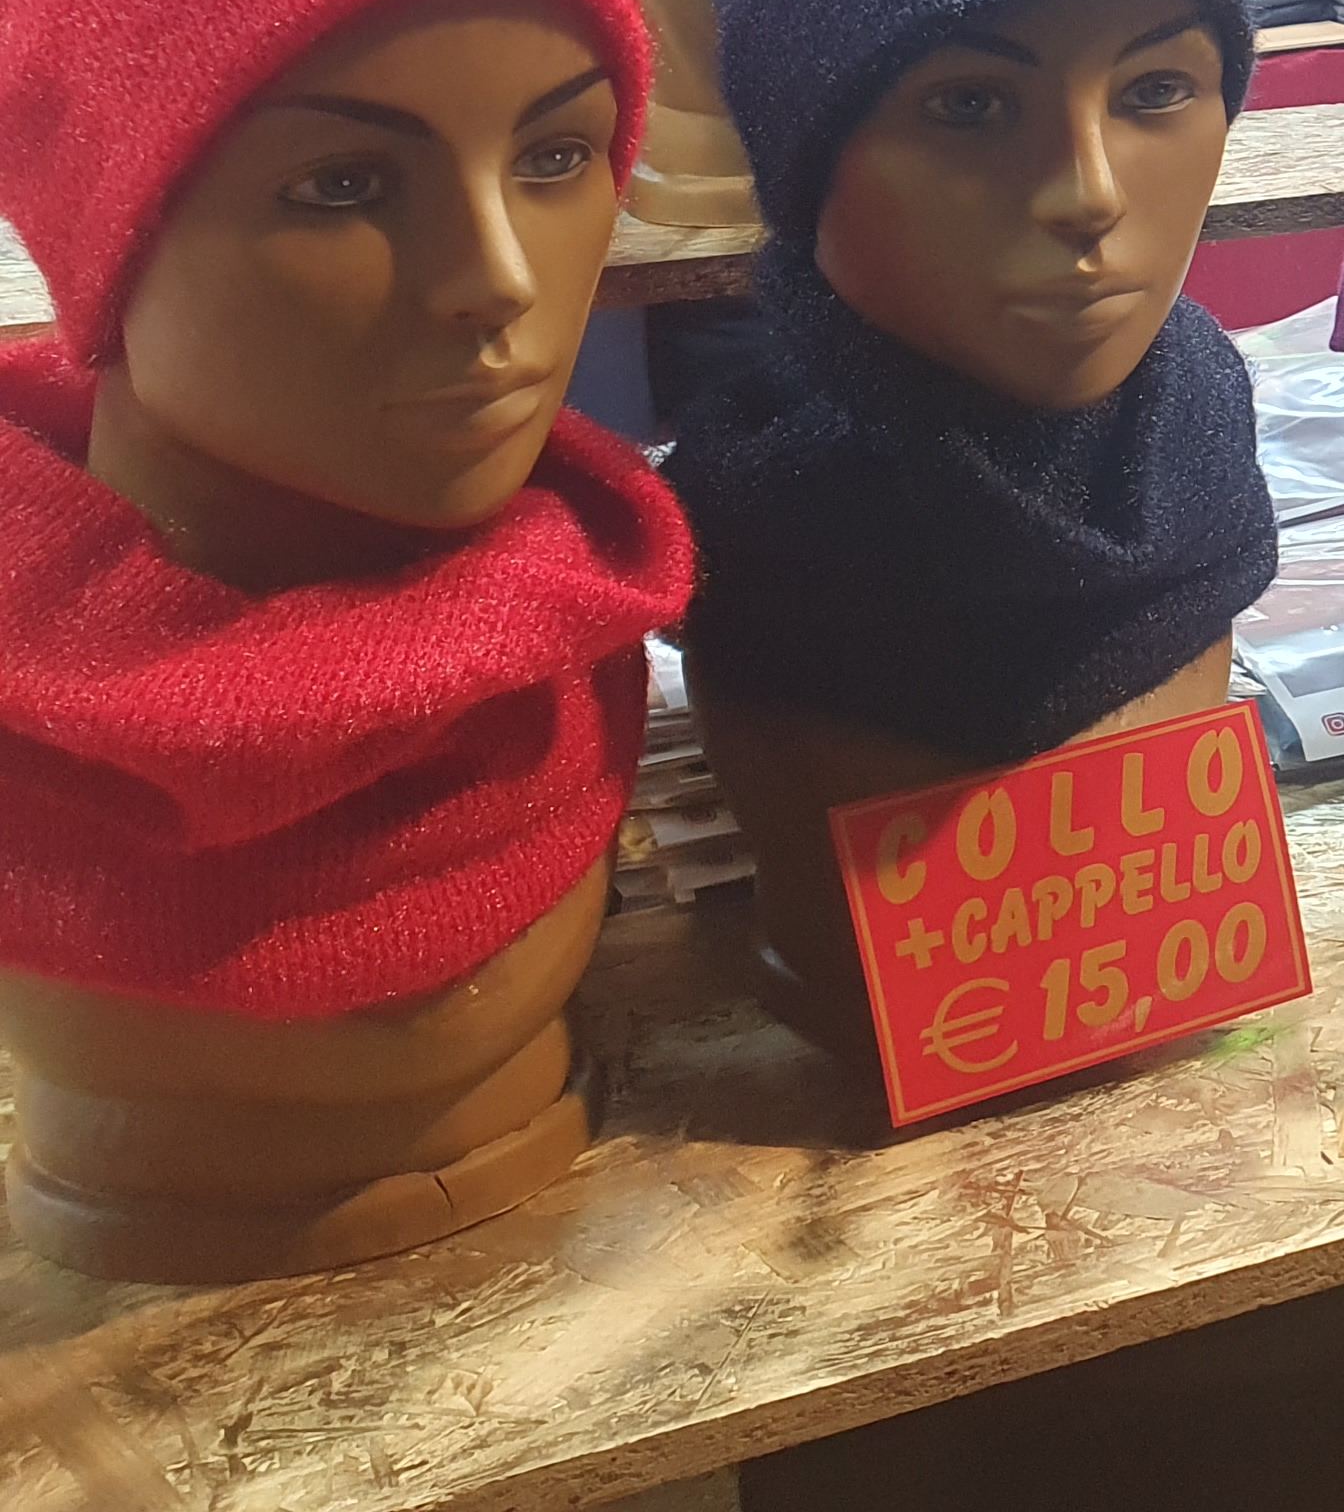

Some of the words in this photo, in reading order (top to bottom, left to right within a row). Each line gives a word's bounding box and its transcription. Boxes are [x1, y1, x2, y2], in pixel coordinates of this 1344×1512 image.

[875, 725, 1245, 905] COLLO
[894, 818, 1262, 971] +CAPPELLO
[1038, 901, 1267, 1040] 15,00
